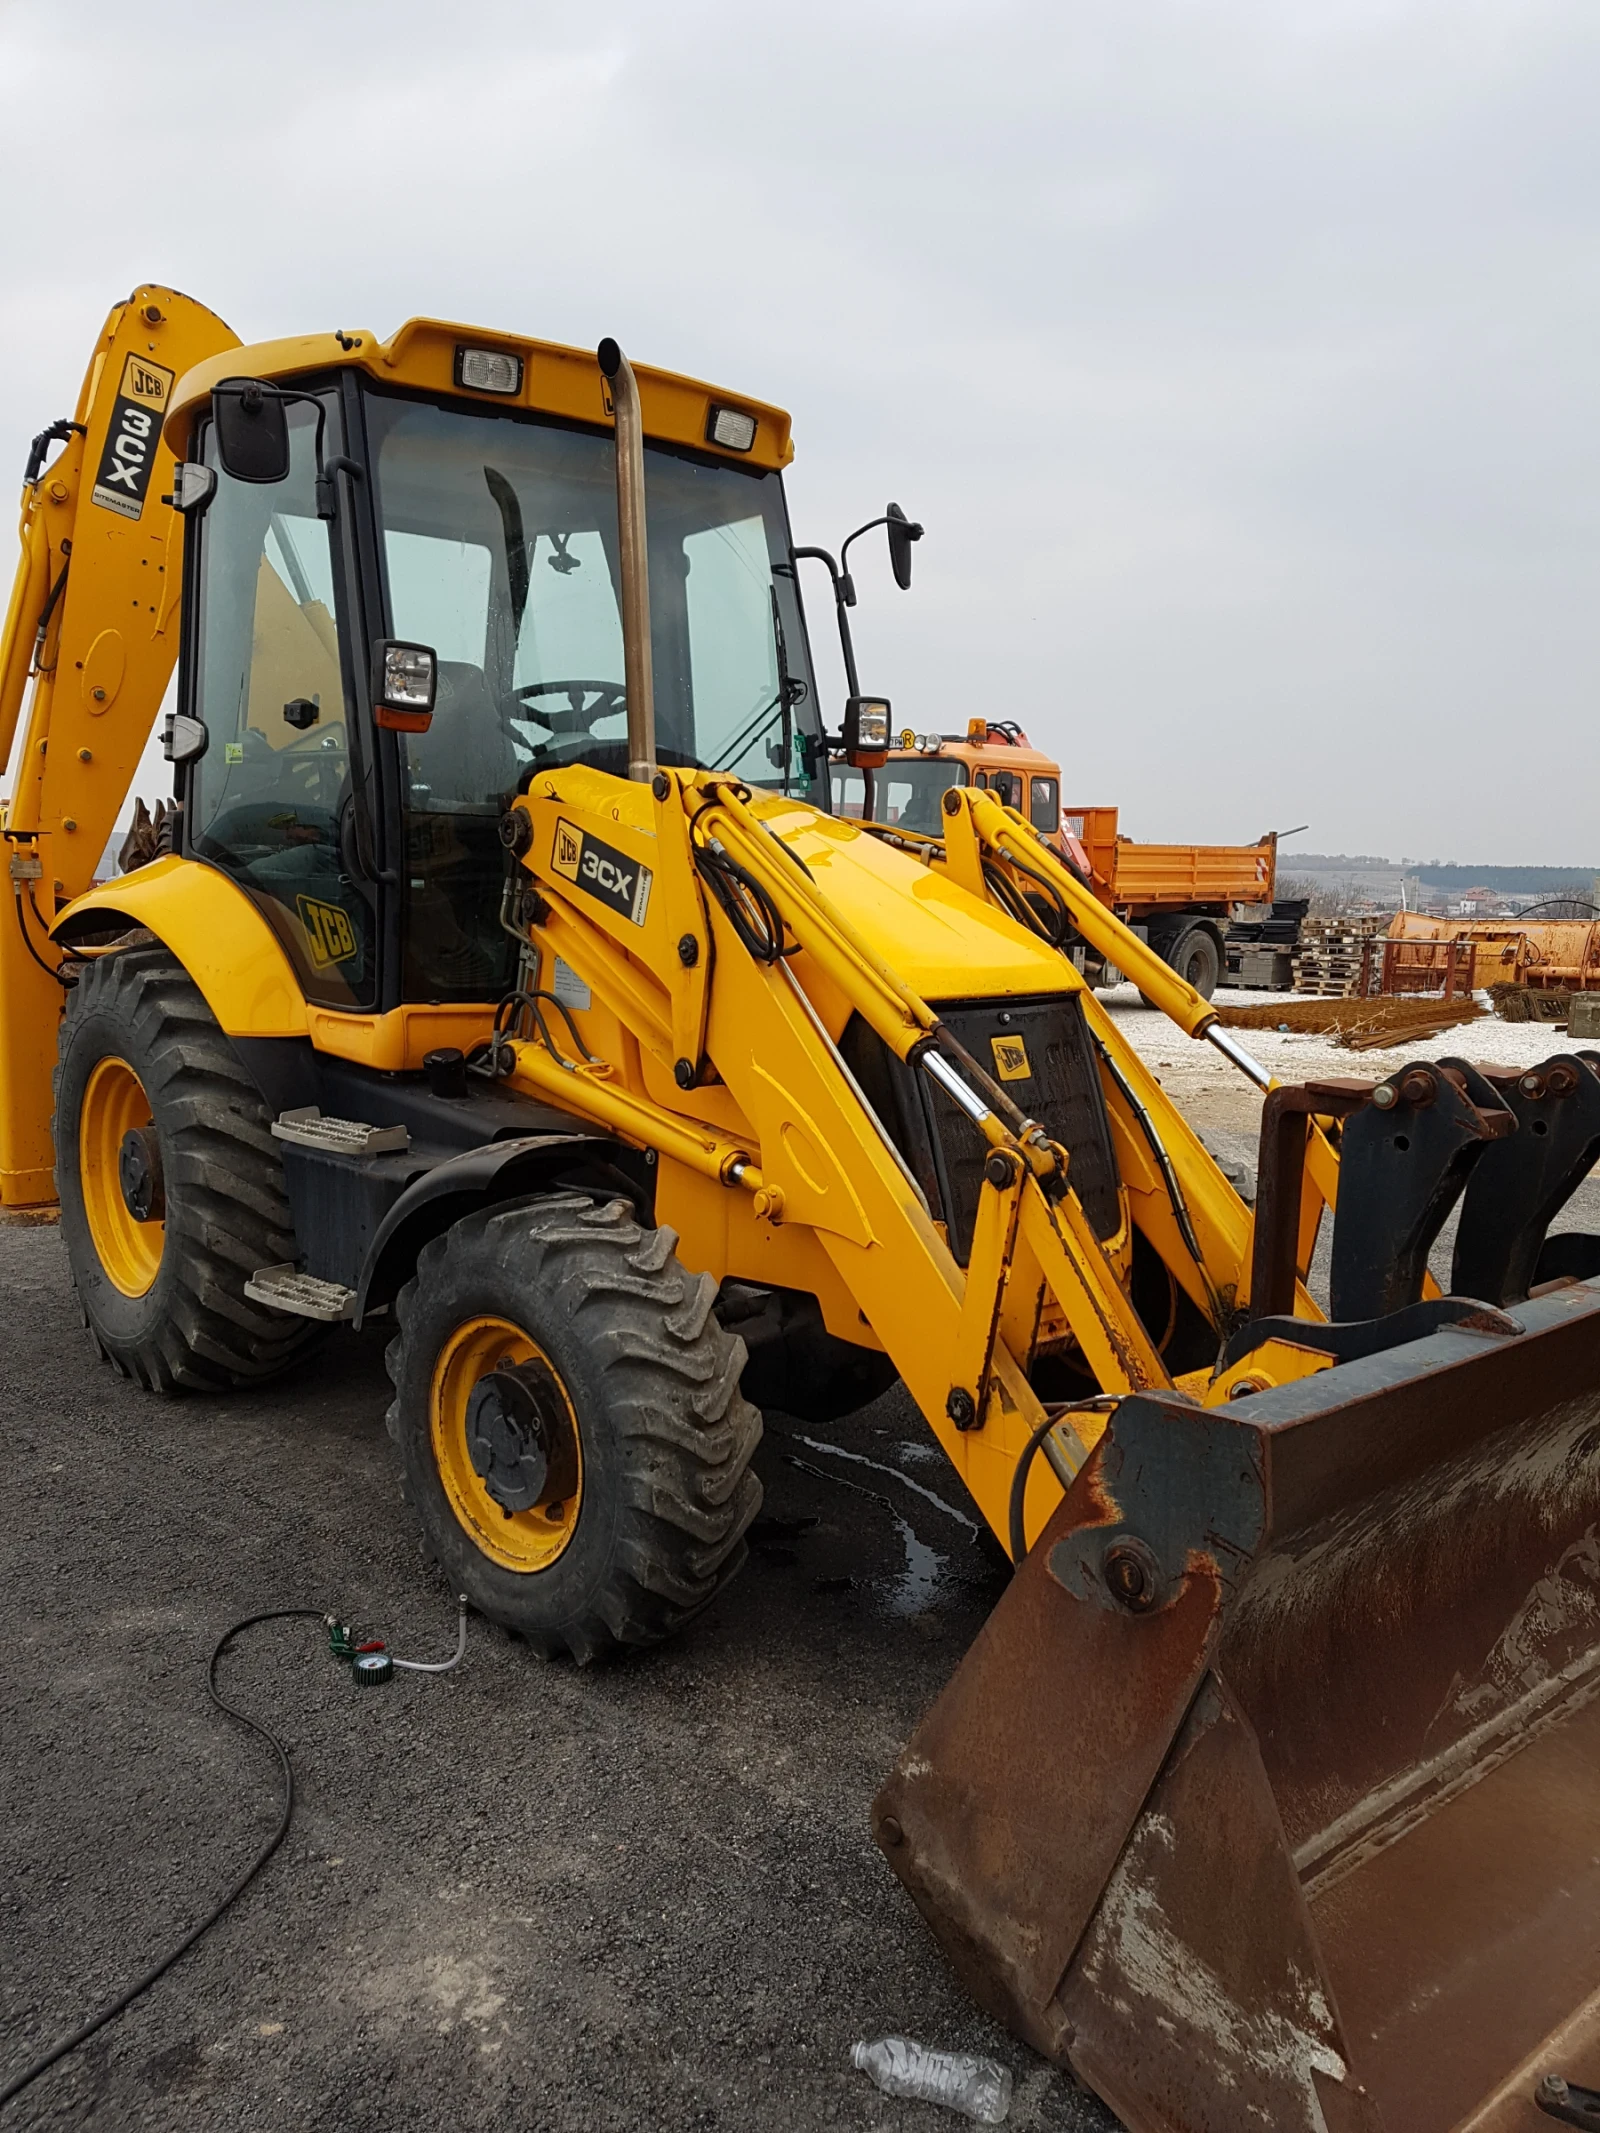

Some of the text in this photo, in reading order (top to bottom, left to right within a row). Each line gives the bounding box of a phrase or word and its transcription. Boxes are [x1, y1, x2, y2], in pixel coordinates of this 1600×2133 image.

[135, 368, 162, 396] JCB
[105, 408, 152, 491] 3CX
[94, 492, 140, 514] SITEMASTER
[904, 733, 912, 746] R
[560, 834, 577, 862] JCB
[582, 850, 633, 901] 3CX
[306, 902, 353, 961] JCB
